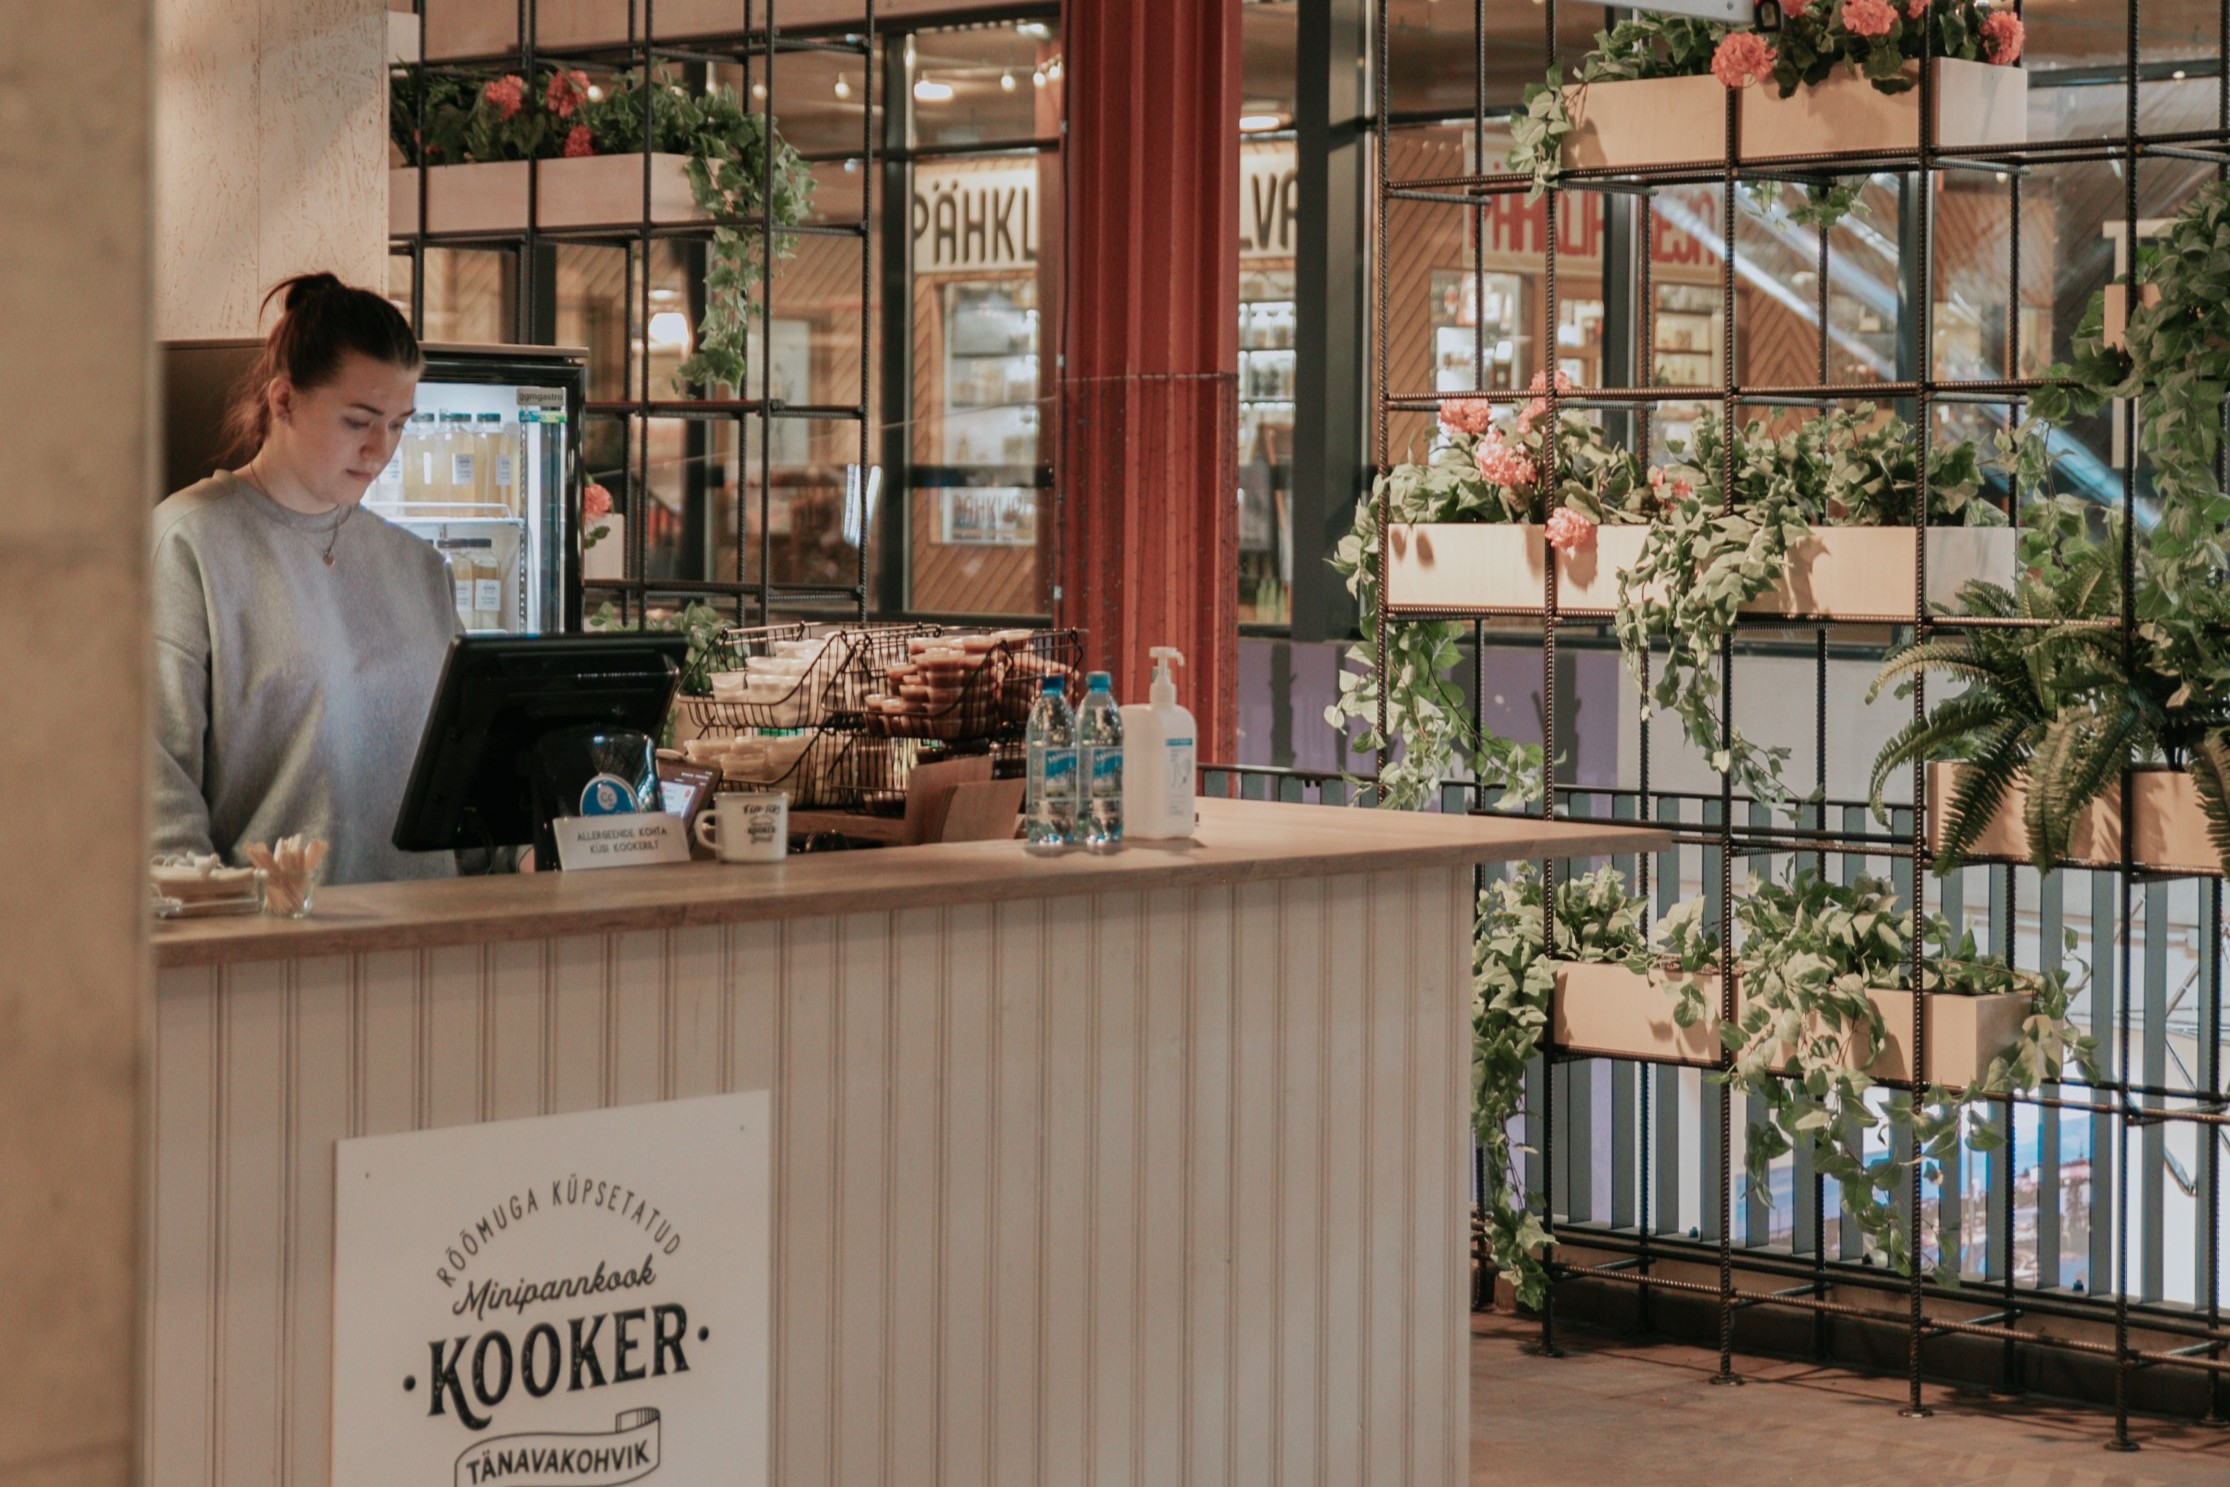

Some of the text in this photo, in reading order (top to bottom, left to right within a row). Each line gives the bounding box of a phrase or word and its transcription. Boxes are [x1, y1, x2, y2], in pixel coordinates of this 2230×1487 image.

[436, 1173, 681, 1288] RÕÕMUGA KÜPSETATUD
[452, 1252, 657, 1320] Minipannkook
[426, 1302, 691, 1431] KOOKER
[466, 1439, 651, 1486] TÄNAVAKOHVIK
